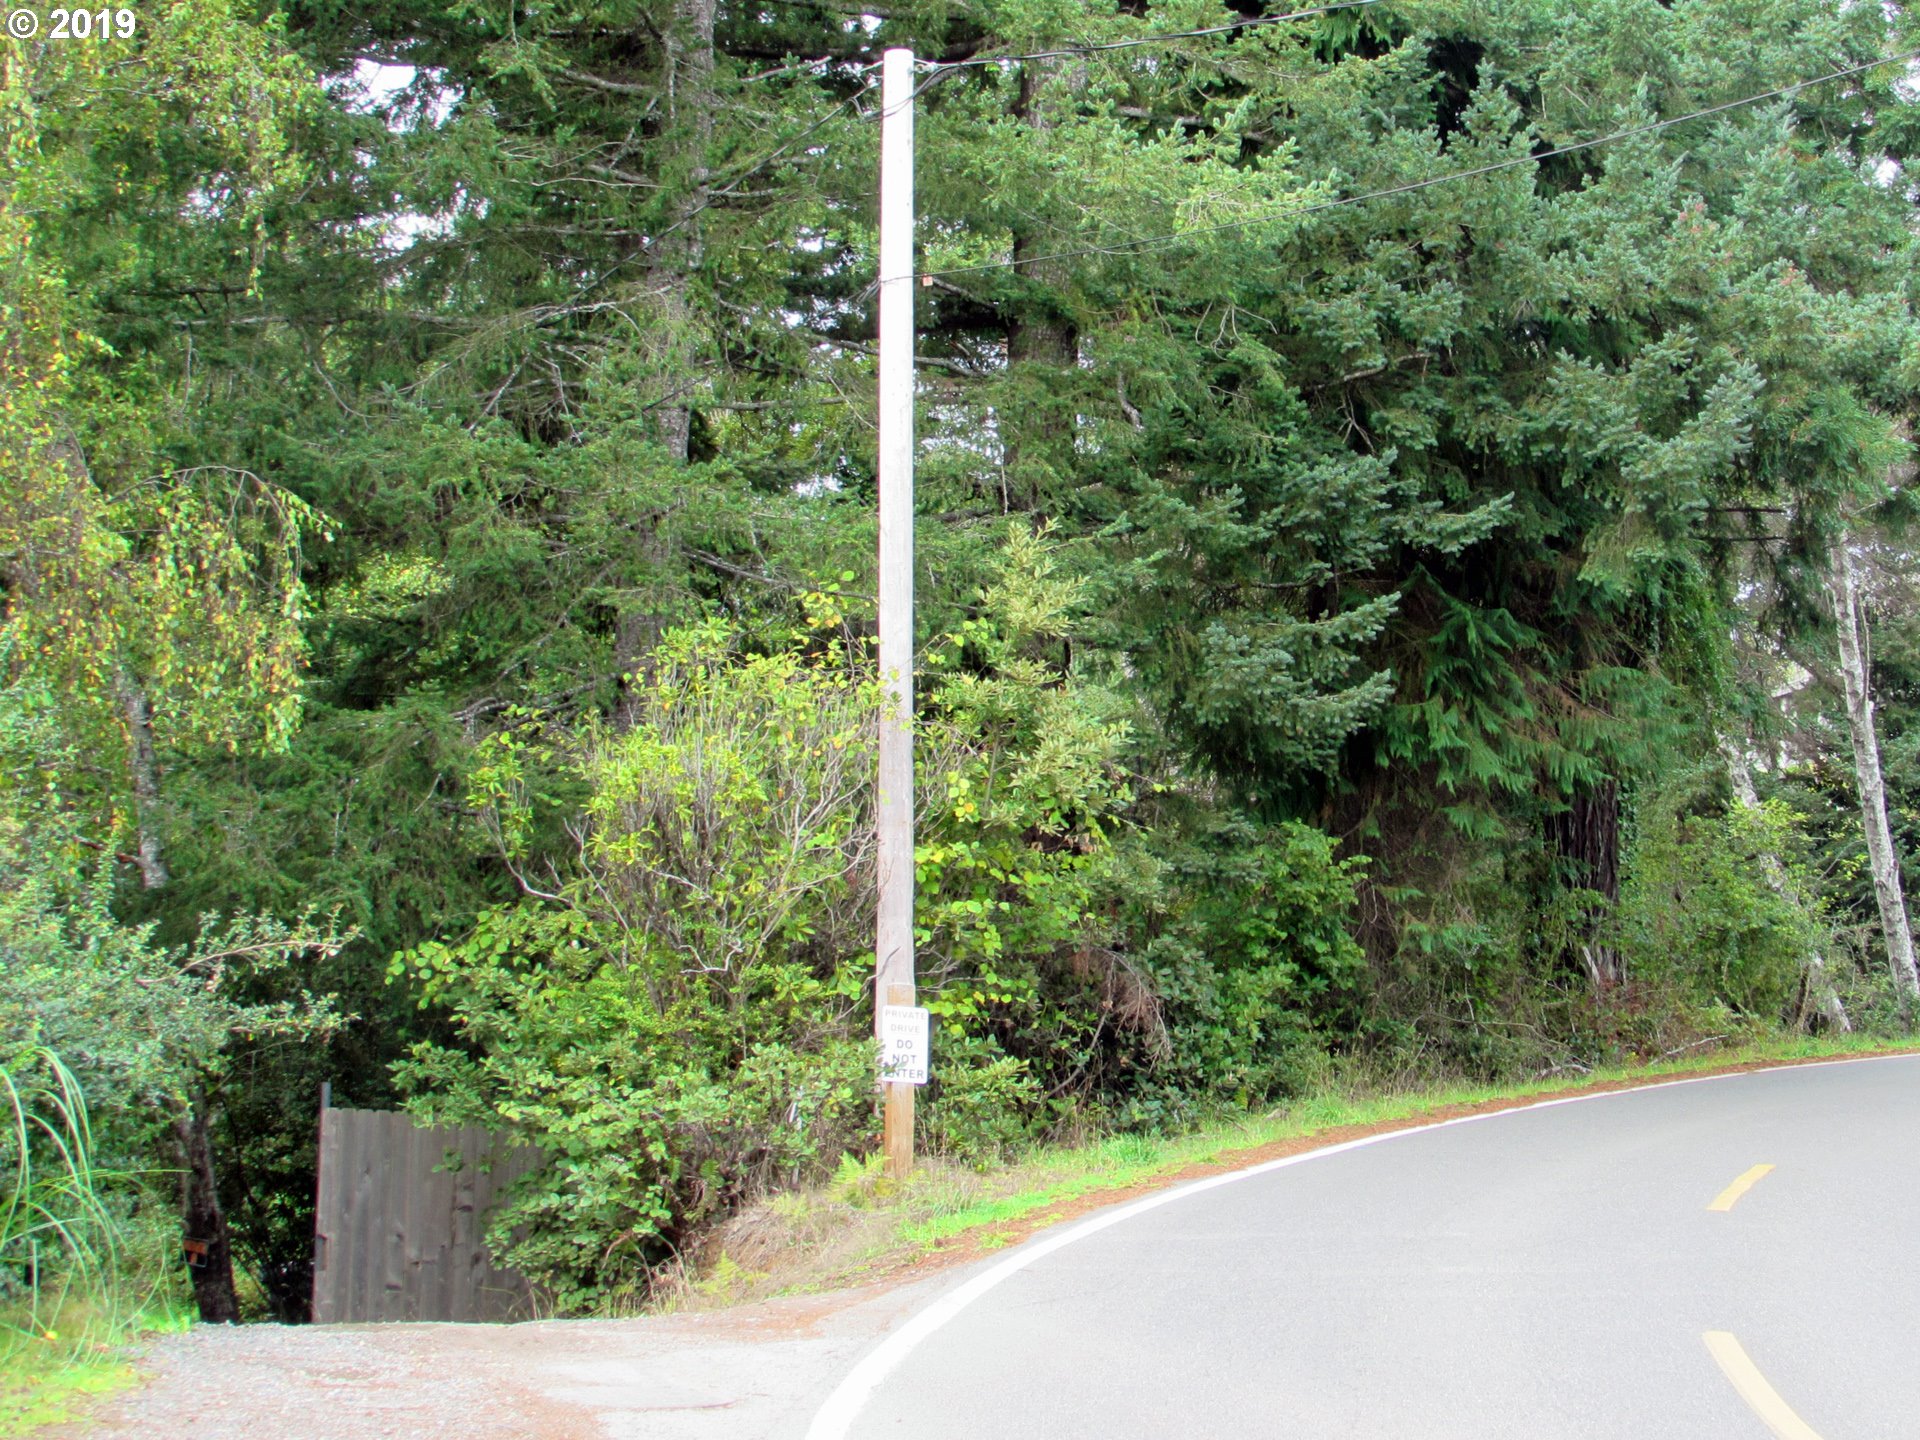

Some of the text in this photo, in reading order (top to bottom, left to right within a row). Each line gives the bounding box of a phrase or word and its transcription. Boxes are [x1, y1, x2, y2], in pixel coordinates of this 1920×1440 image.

[885, 1009, 926, 1020] PRIVATE
[891, 1024, 920, 1033] DRIVE
[897, 1039, 913, 1049] DO
[892, 1054, 917, 1064] NOT
